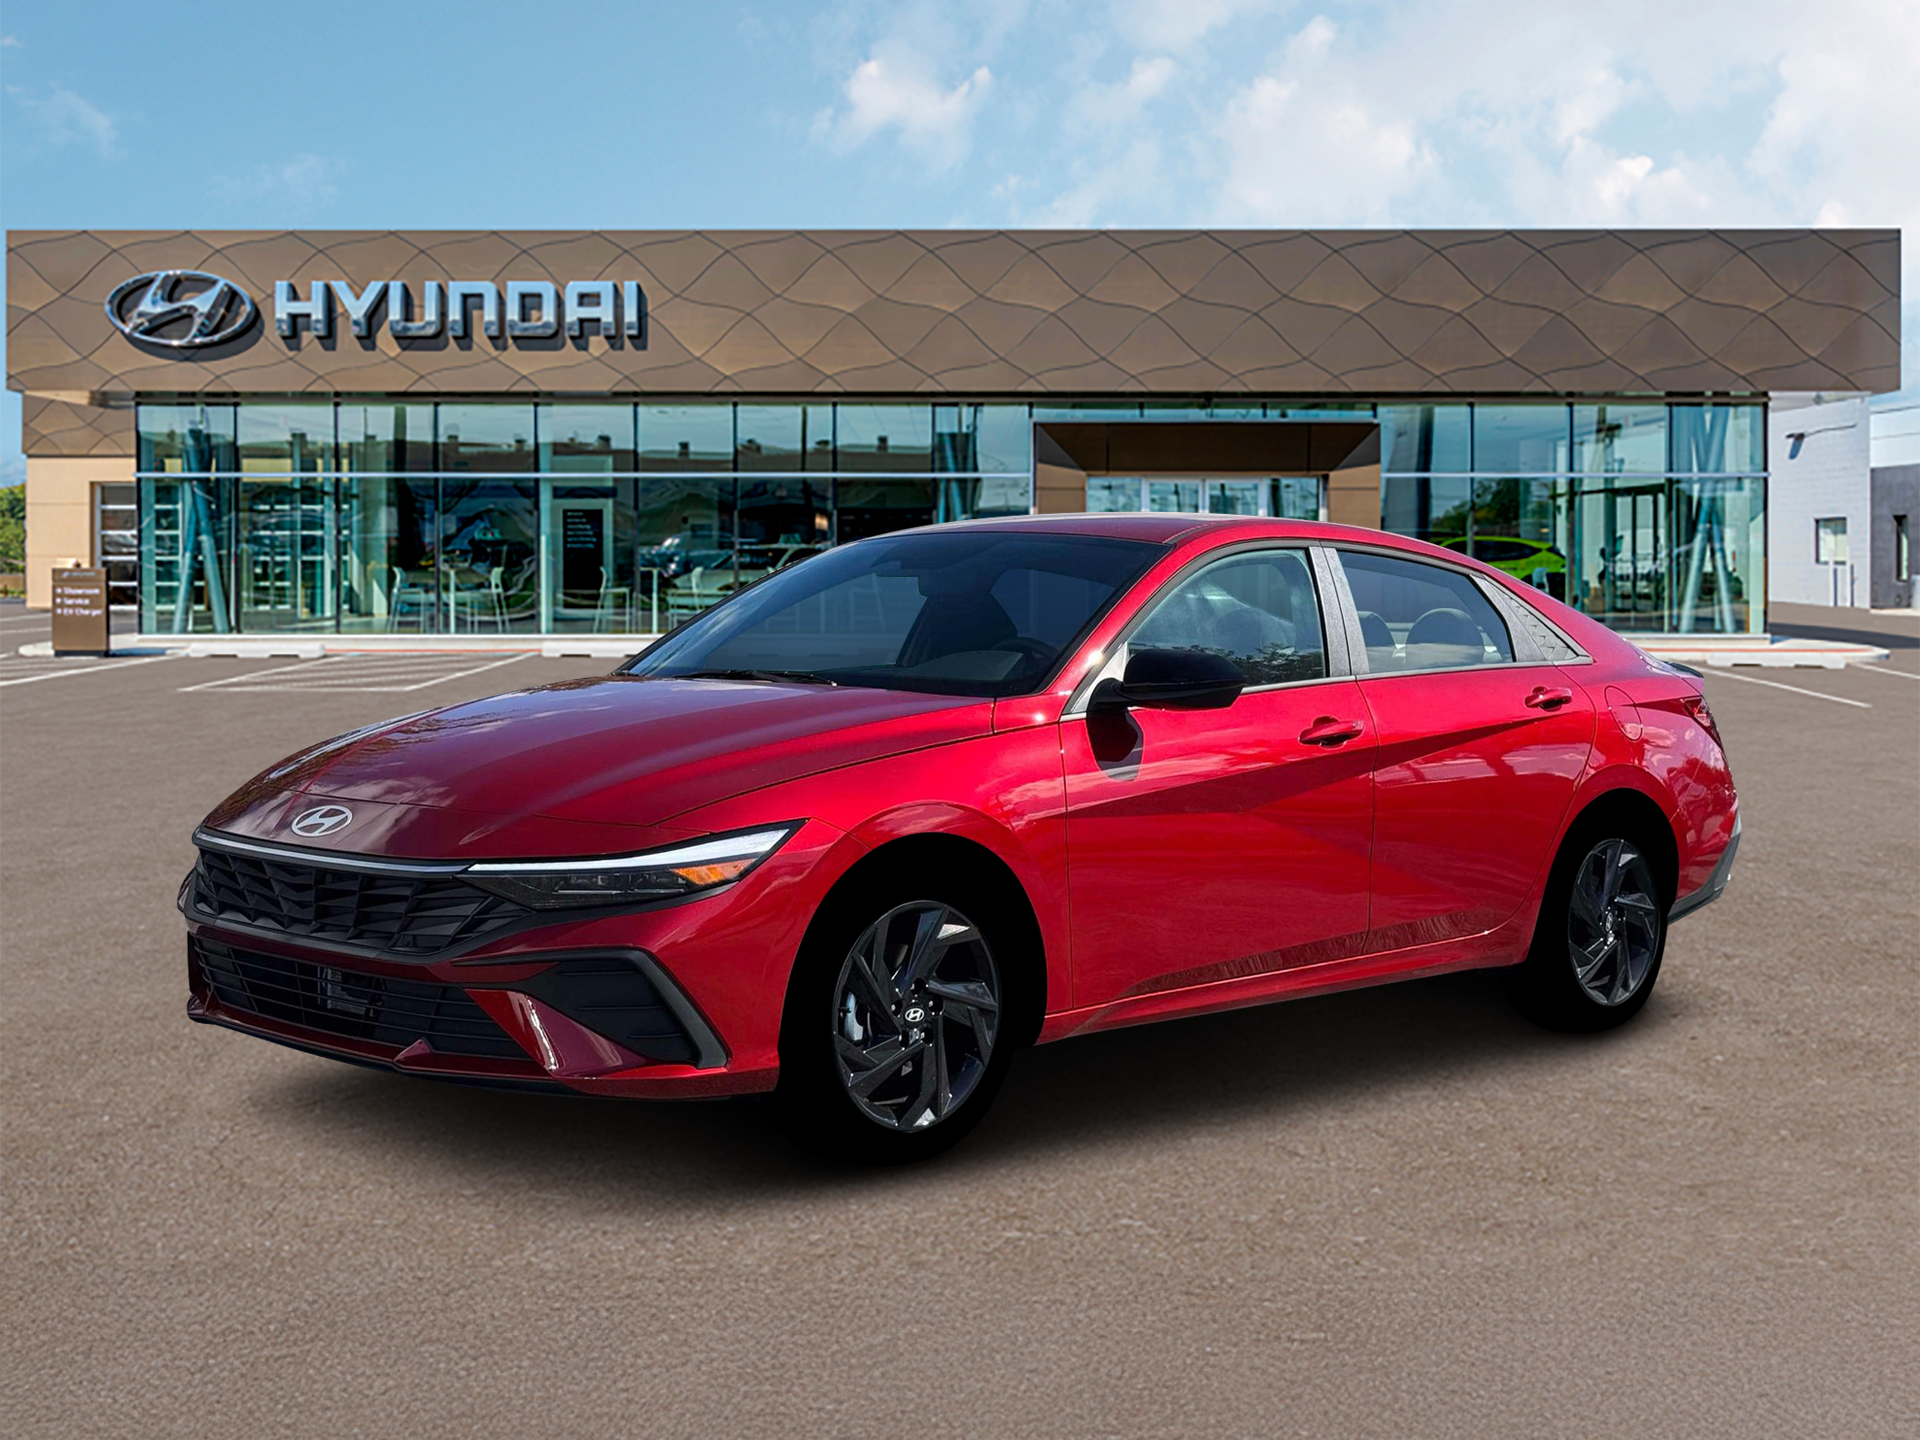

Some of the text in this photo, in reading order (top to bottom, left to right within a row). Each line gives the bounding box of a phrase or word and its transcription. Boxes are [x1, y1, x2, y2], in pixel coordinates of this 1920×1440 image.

[274, 280, 642, 339] HYUNDAI
[63, 587, 100, 595] Showroom
[63, 597, 90, 605] Service
[75, 608, 102, 617] Charger
